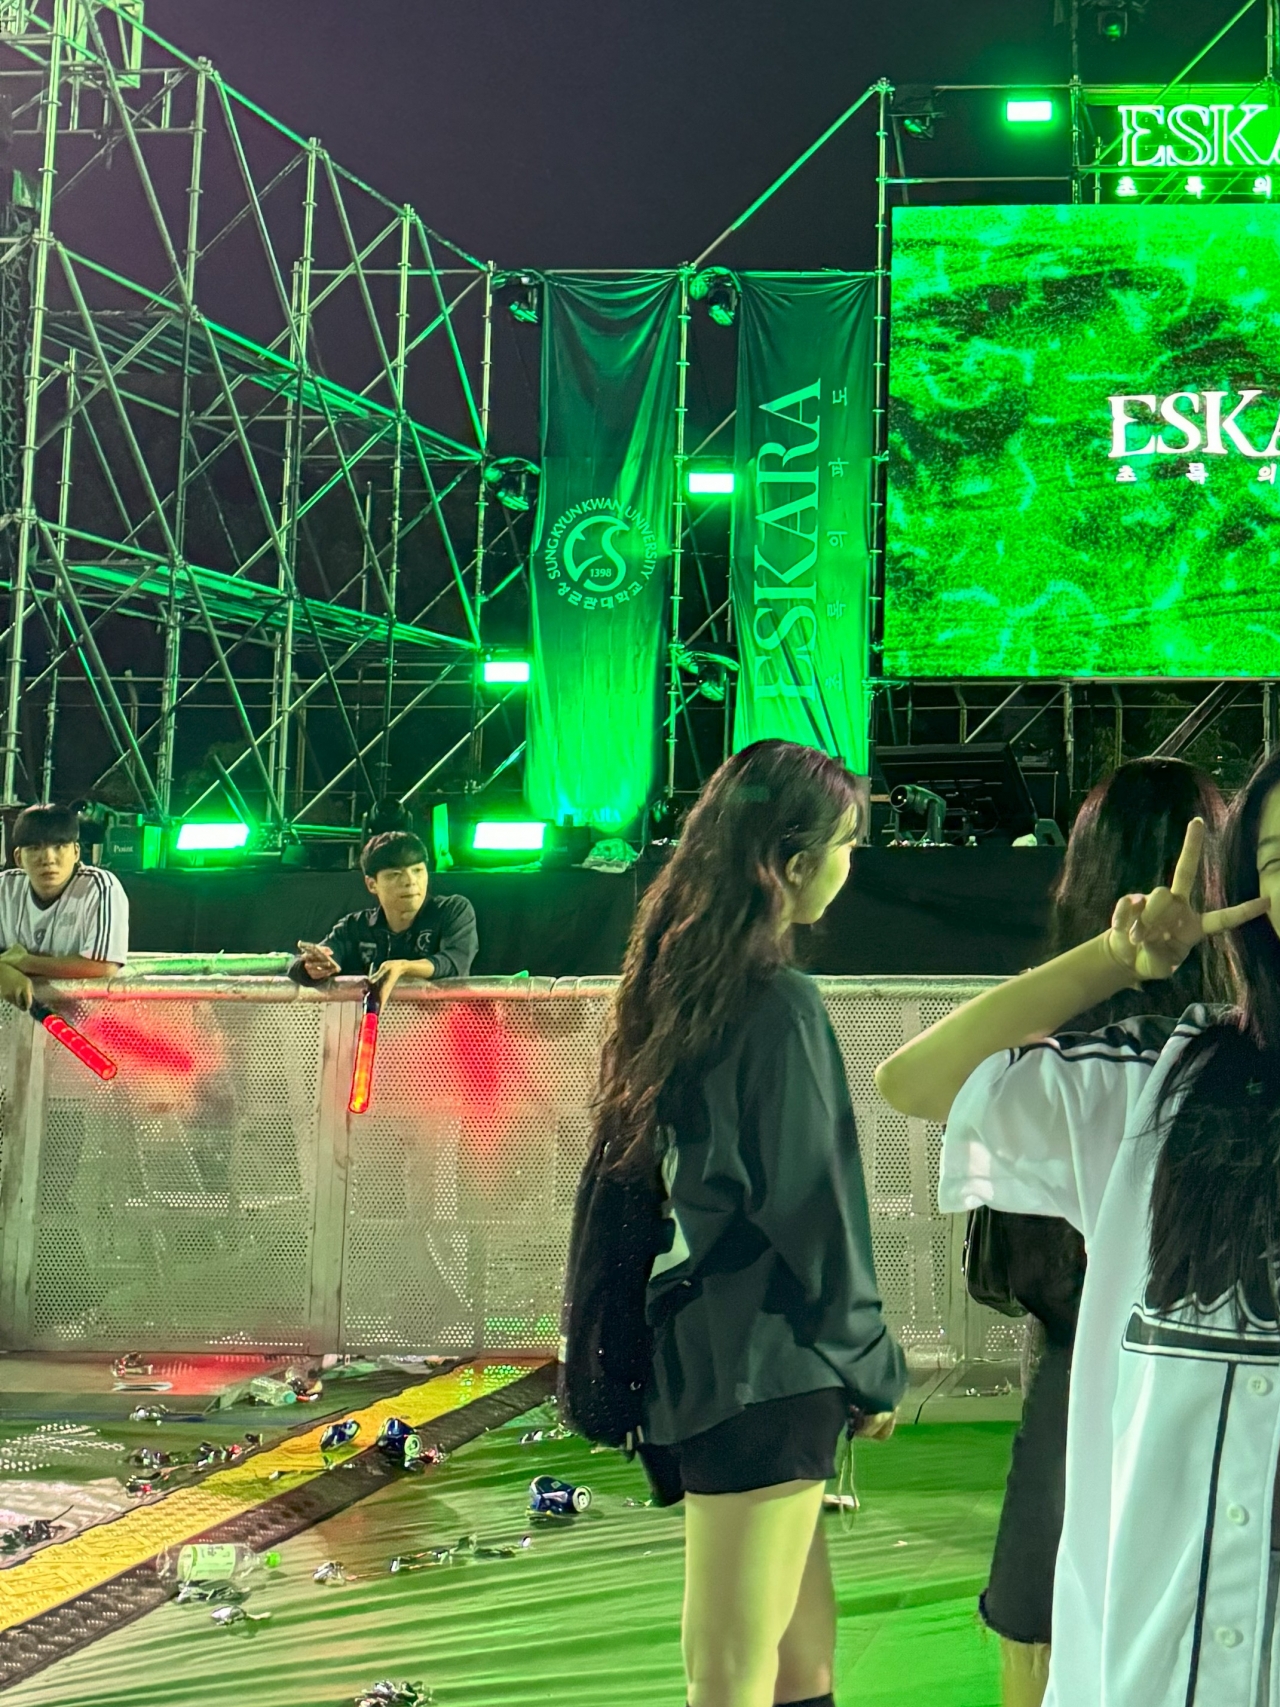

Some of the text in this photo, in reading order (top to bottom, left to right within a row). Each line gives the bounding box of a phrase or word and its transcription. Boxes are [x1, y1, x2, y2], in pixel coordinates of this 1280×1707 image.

[545, 497, 658, 580] SUNGKYUNKWAN UNIVERSITY
[590, 568, 612, 578] 1398
[753, 377, 822, 701] ESKARA
